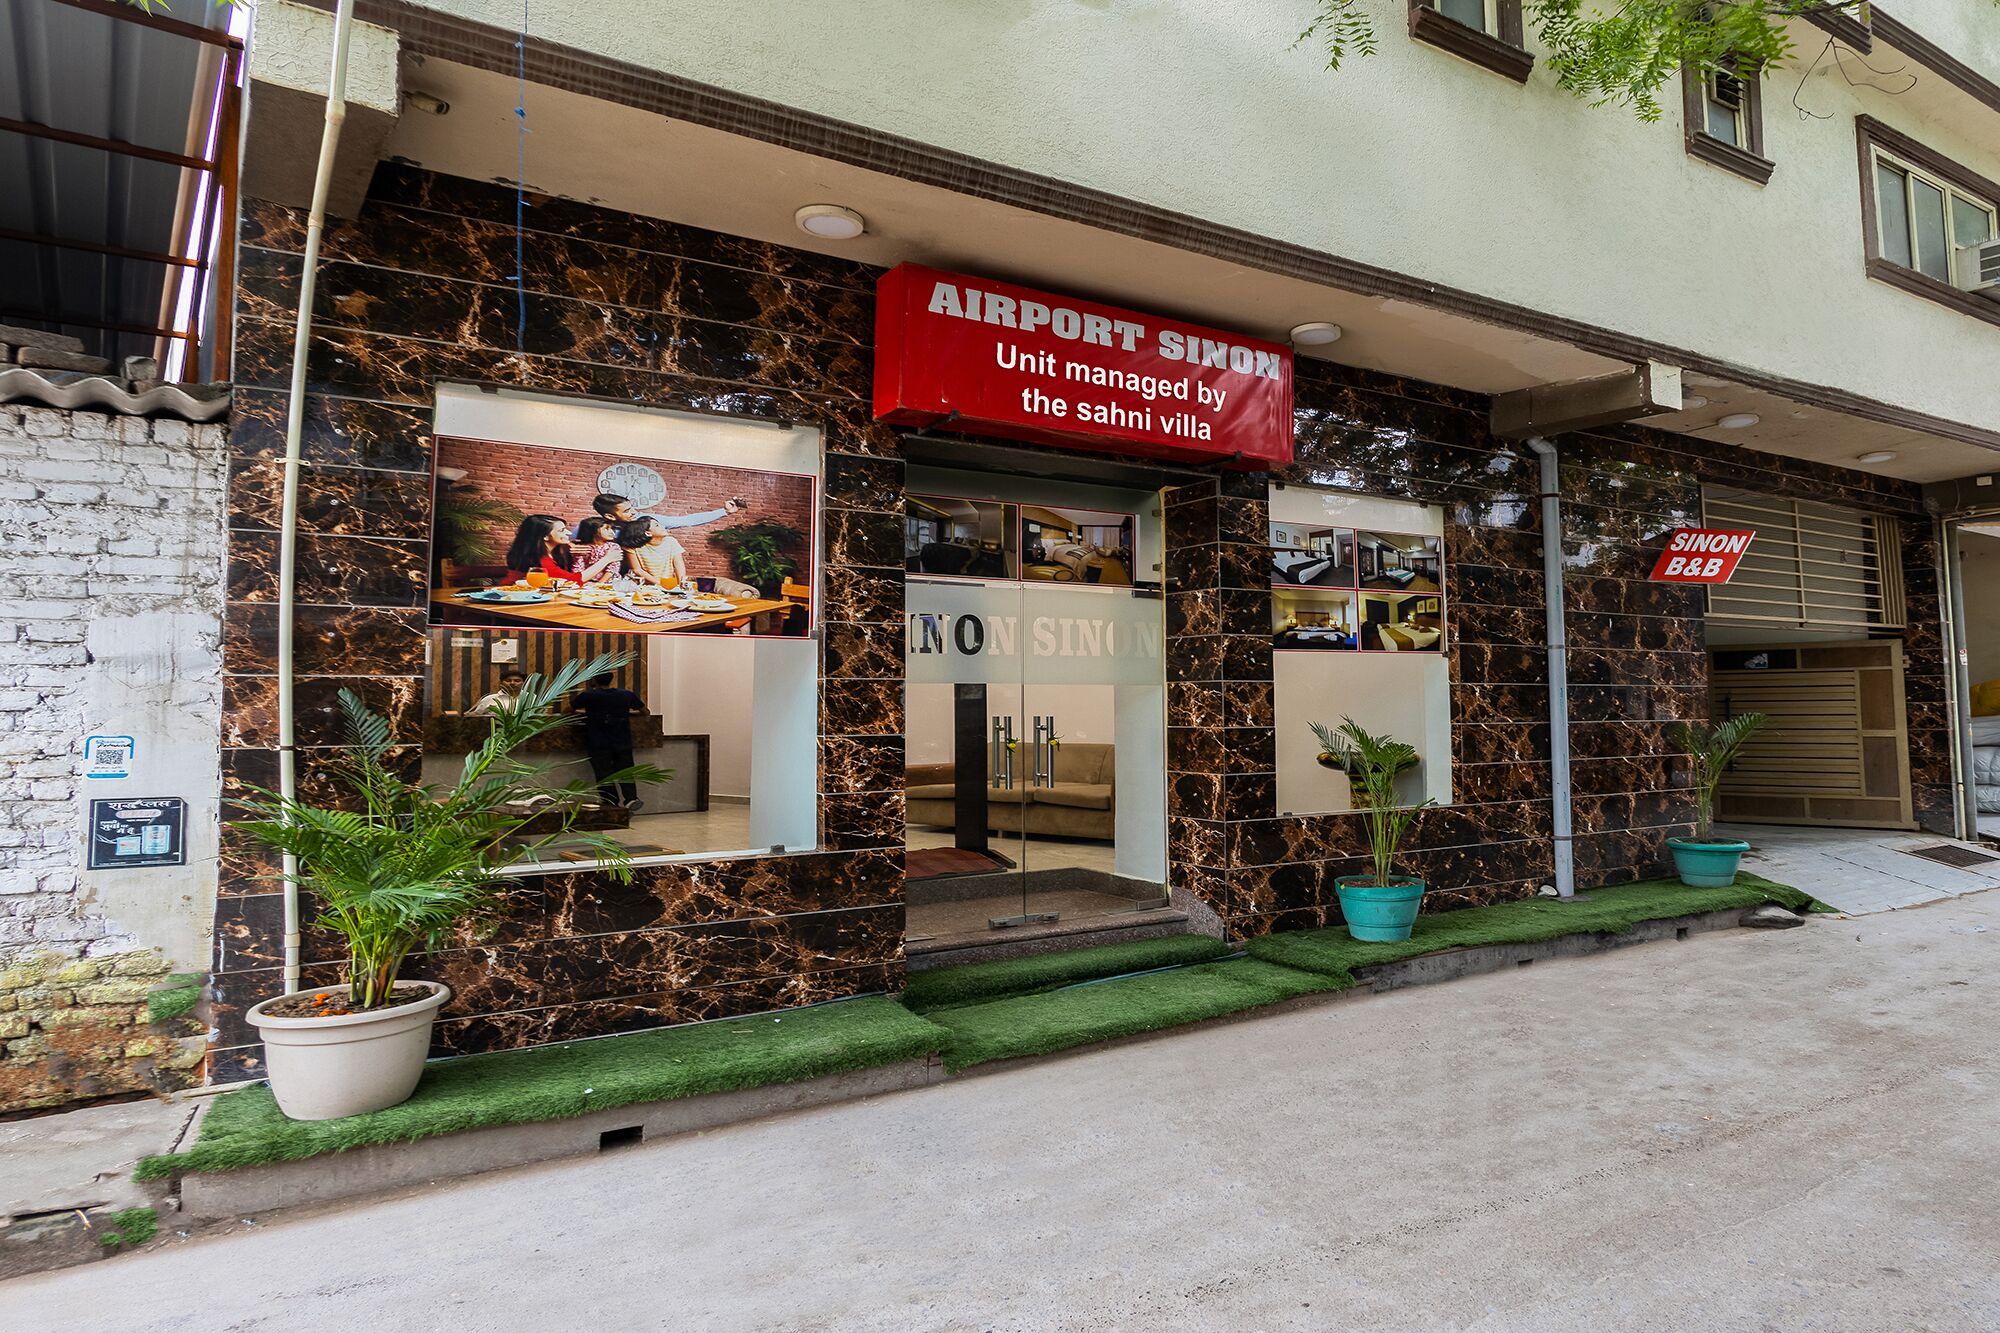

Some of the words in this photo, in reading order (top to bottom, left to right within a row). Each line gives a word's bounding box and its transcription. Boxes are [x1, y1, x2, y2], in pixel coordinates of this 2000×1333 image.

[928, 282, 1145, 352] AIRPORT
[1159, 330, 1281, 380] SINON
[996, 342, 1056, 377] Unit
[1065, 361, 1189, 402] managed
[1197, 379, 1227, 412] by
[1022, 388, 1067, 417] the
[1076, 402, 1152, 431] sahni
[1160, 414, 1212, 440] villa
[1670, 533, 1747, 553] SINON
[1664, 557, 1724, 577] B&B
[1033, 617, 1160, 658] SINON
